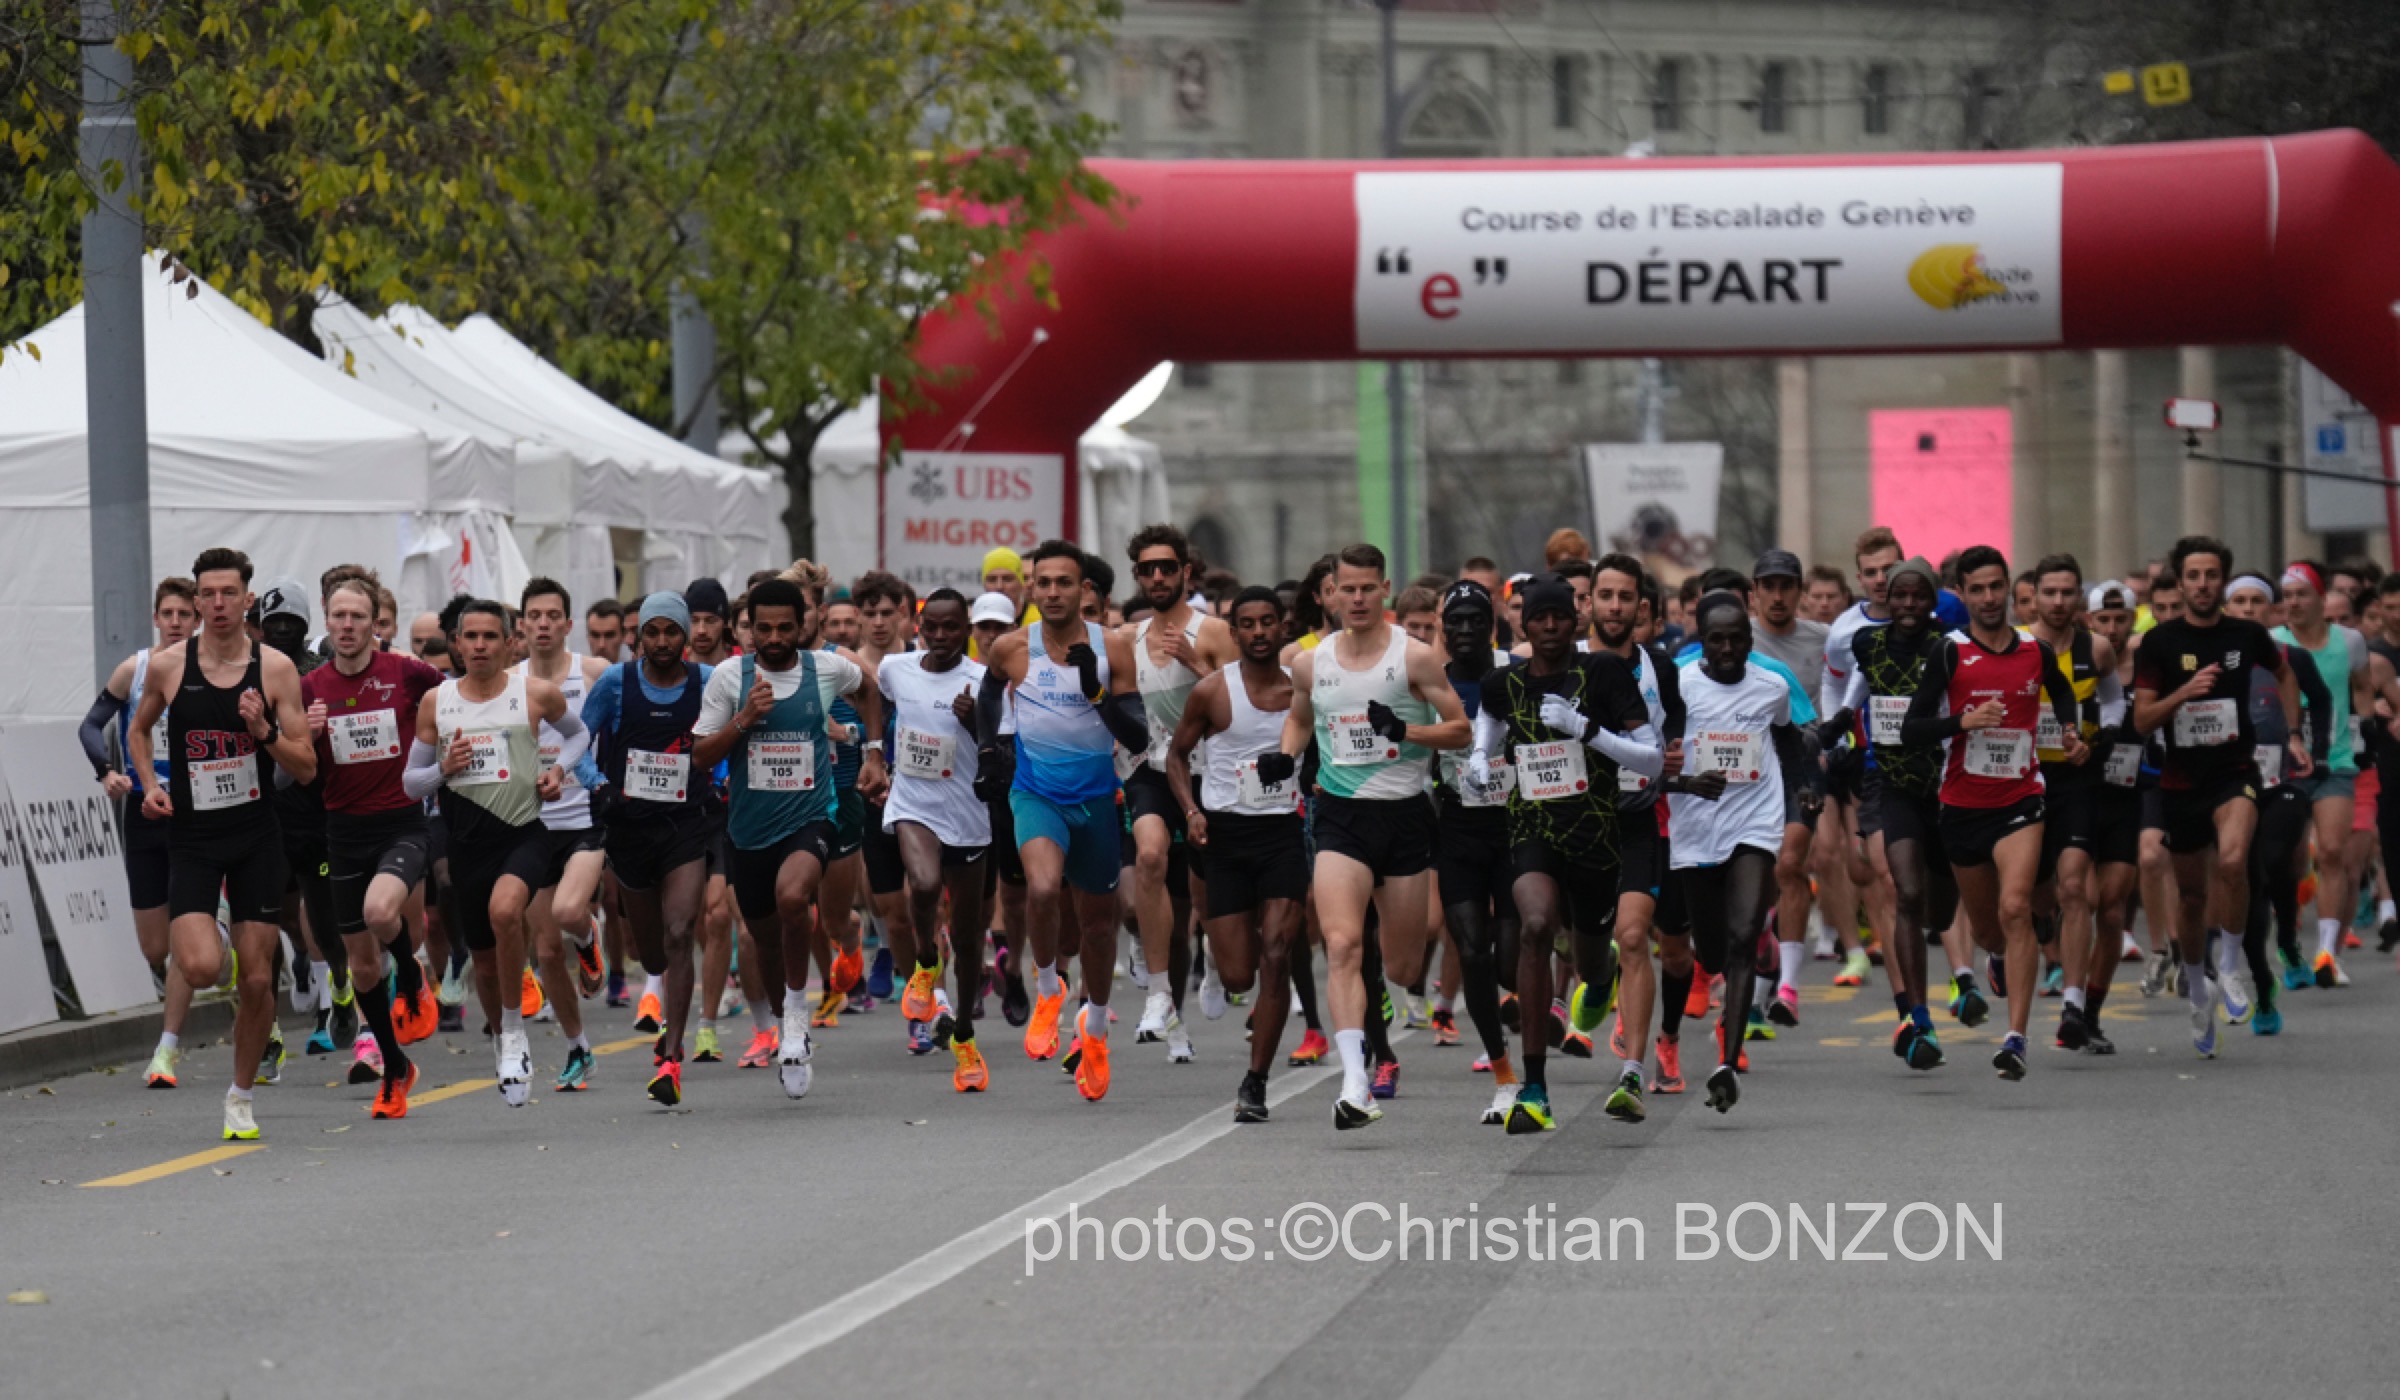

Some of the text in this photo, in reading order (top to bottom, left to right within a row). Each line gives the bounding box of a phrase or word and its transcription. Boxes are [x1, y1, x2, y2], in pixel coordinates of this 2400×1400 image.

[1461, 198, 1975, 232] Course de l'Escalade Genève
[1586, 247, 1842, 303] DÉPART
[955, 466, 1033, 501] UBS
[904, 517, 1037, 547] MIGROS
[357, 714, 379, 725] UBS
[354, 736, 377, 748] 106
[1352, 737, 1373, 750] 103
[1707, 732, 1749, 743] MIGROS
[349, 749, 385, 761] MIGROS
[762, 745, 801, 753] MIGROS
[1539, 744, 1565, 757] UBS
[202, 760, 244, 772] MIGROS
[656, 755, 677, 766] UBS
[912, 754, 933, 767] 172
[1717, 757, 1739, 768] 173
[770, 767, 793, 777] 105
[1537, 769, 1562, 783] 102
[648, 776, 668, 788] 112
[777, 779, 799, 788] UBS
[216, 782, 237, 795] 111
[1532, 784, 1571, 797] MIGROS
